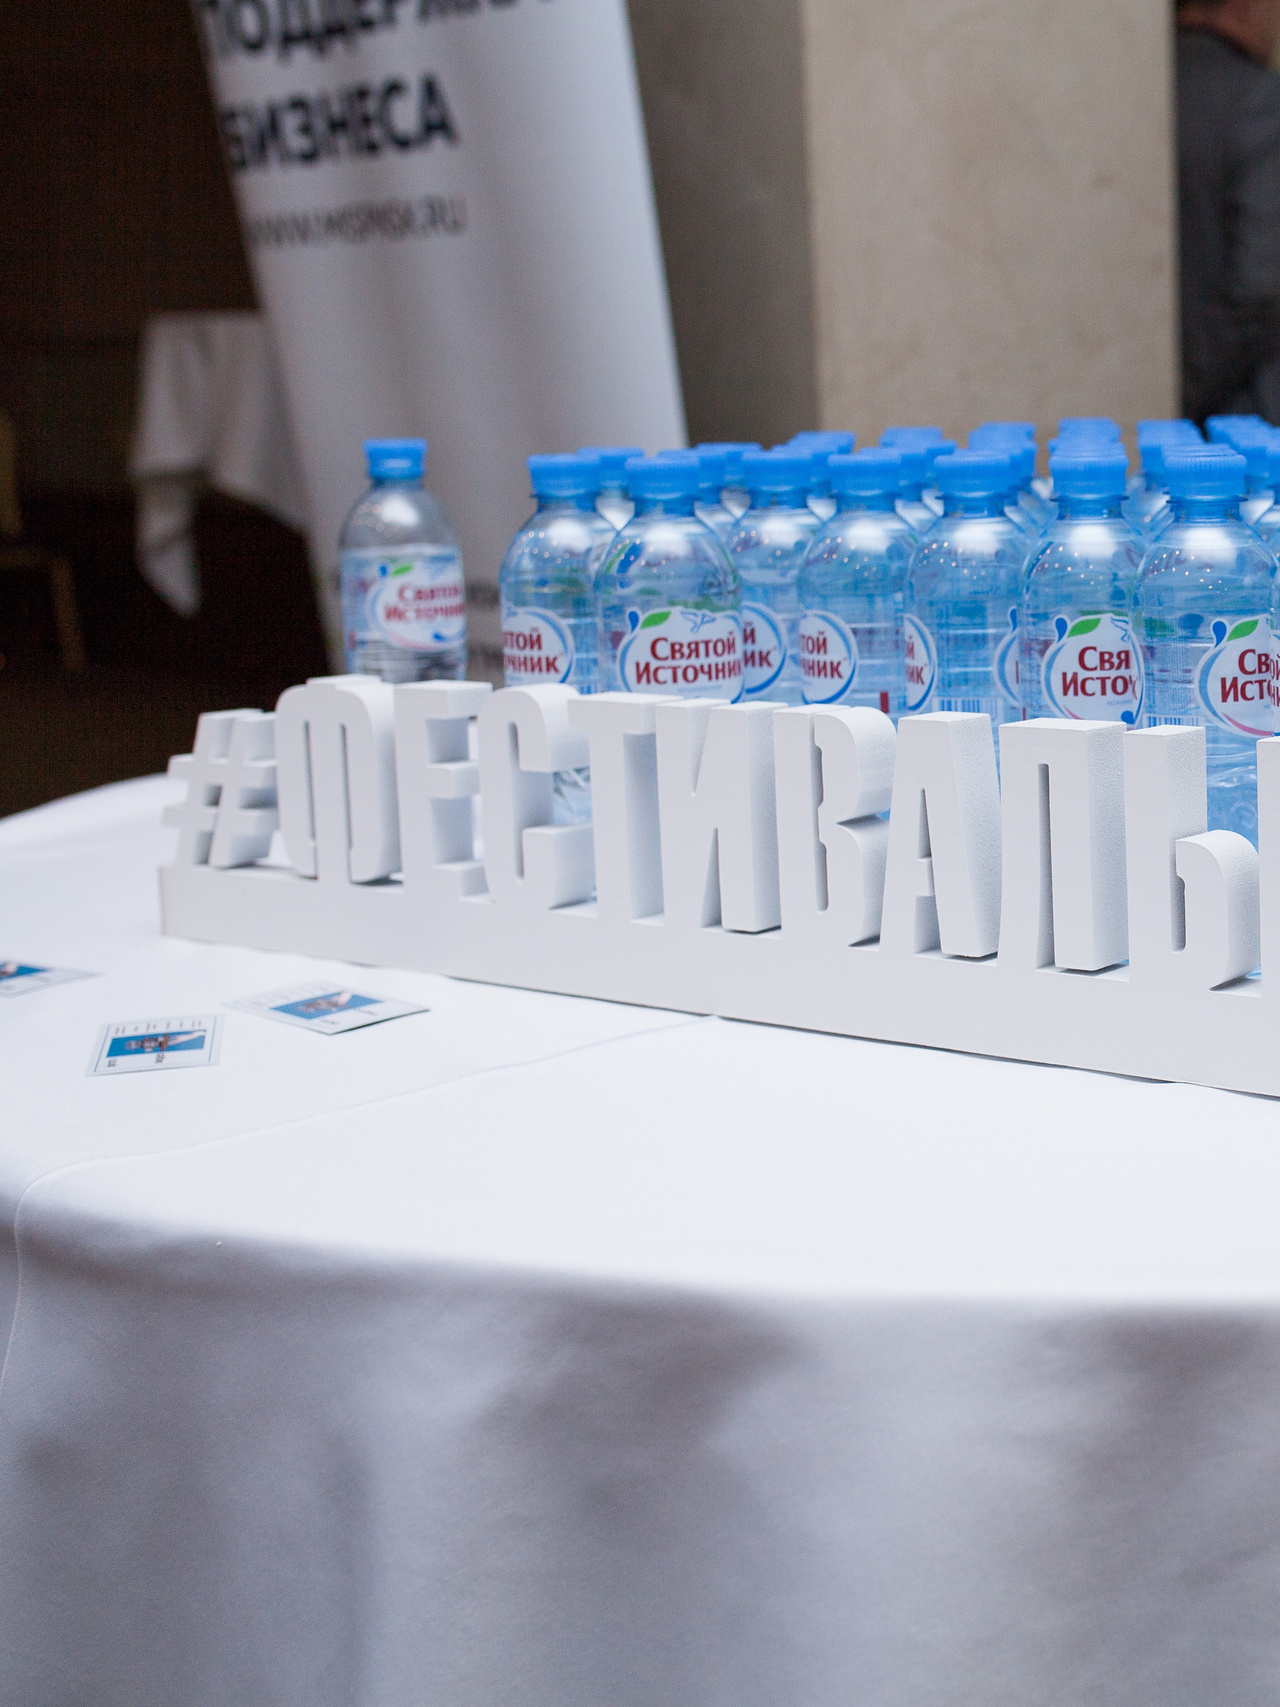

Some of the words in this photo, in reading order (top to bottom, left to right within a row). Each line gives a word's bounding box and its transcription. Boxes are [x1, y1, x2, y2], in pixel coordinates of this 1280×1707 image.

[220, 73, 461, 171] БИЗНЕСА
[650, 630, 736, 662] Святой
[1078, 645, 1131, 672] Свя
[1061, 671, 1134, 697] Исто
